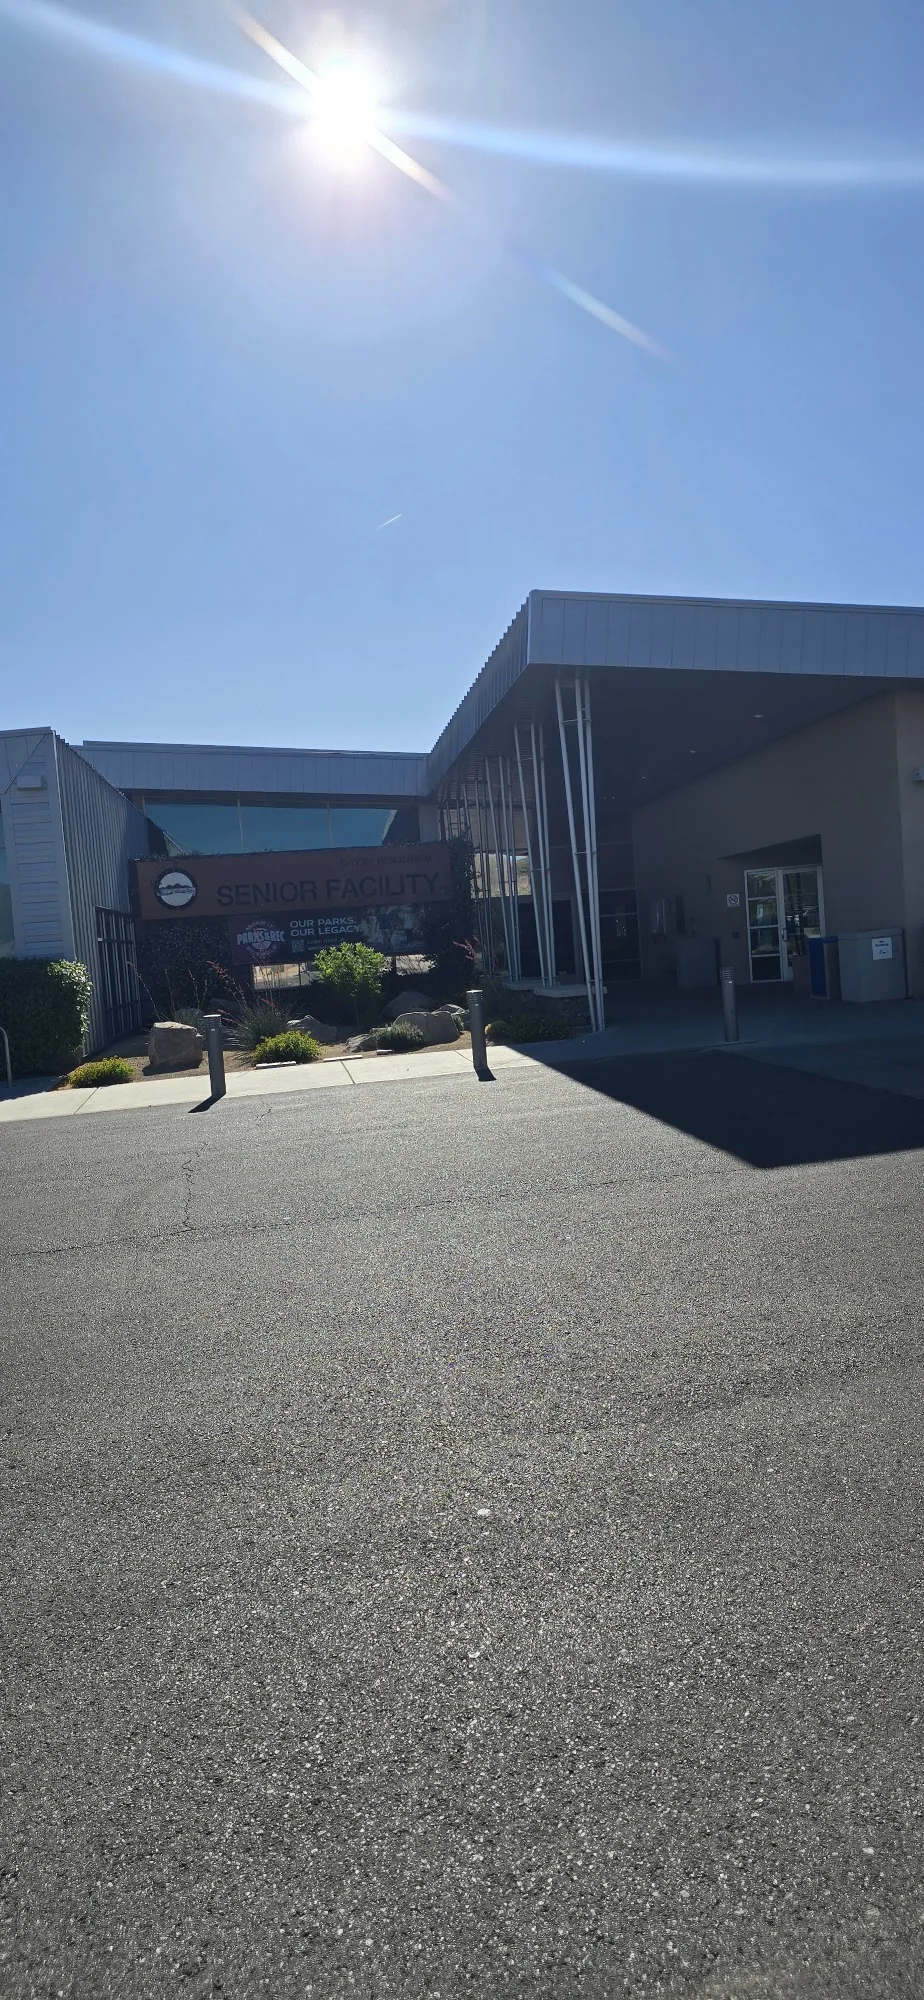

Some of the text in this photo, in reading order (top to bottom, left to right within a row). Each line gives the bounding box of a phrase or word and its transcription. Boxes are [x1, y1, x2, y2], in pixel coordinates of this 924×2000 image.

[363, 857, 374, 866] OF
[217, 872, 439, 906] SENIOR FACILITY
[289, 916, 357, 929] OUR PARKS.
[290, 928, 315, 937] OUR
